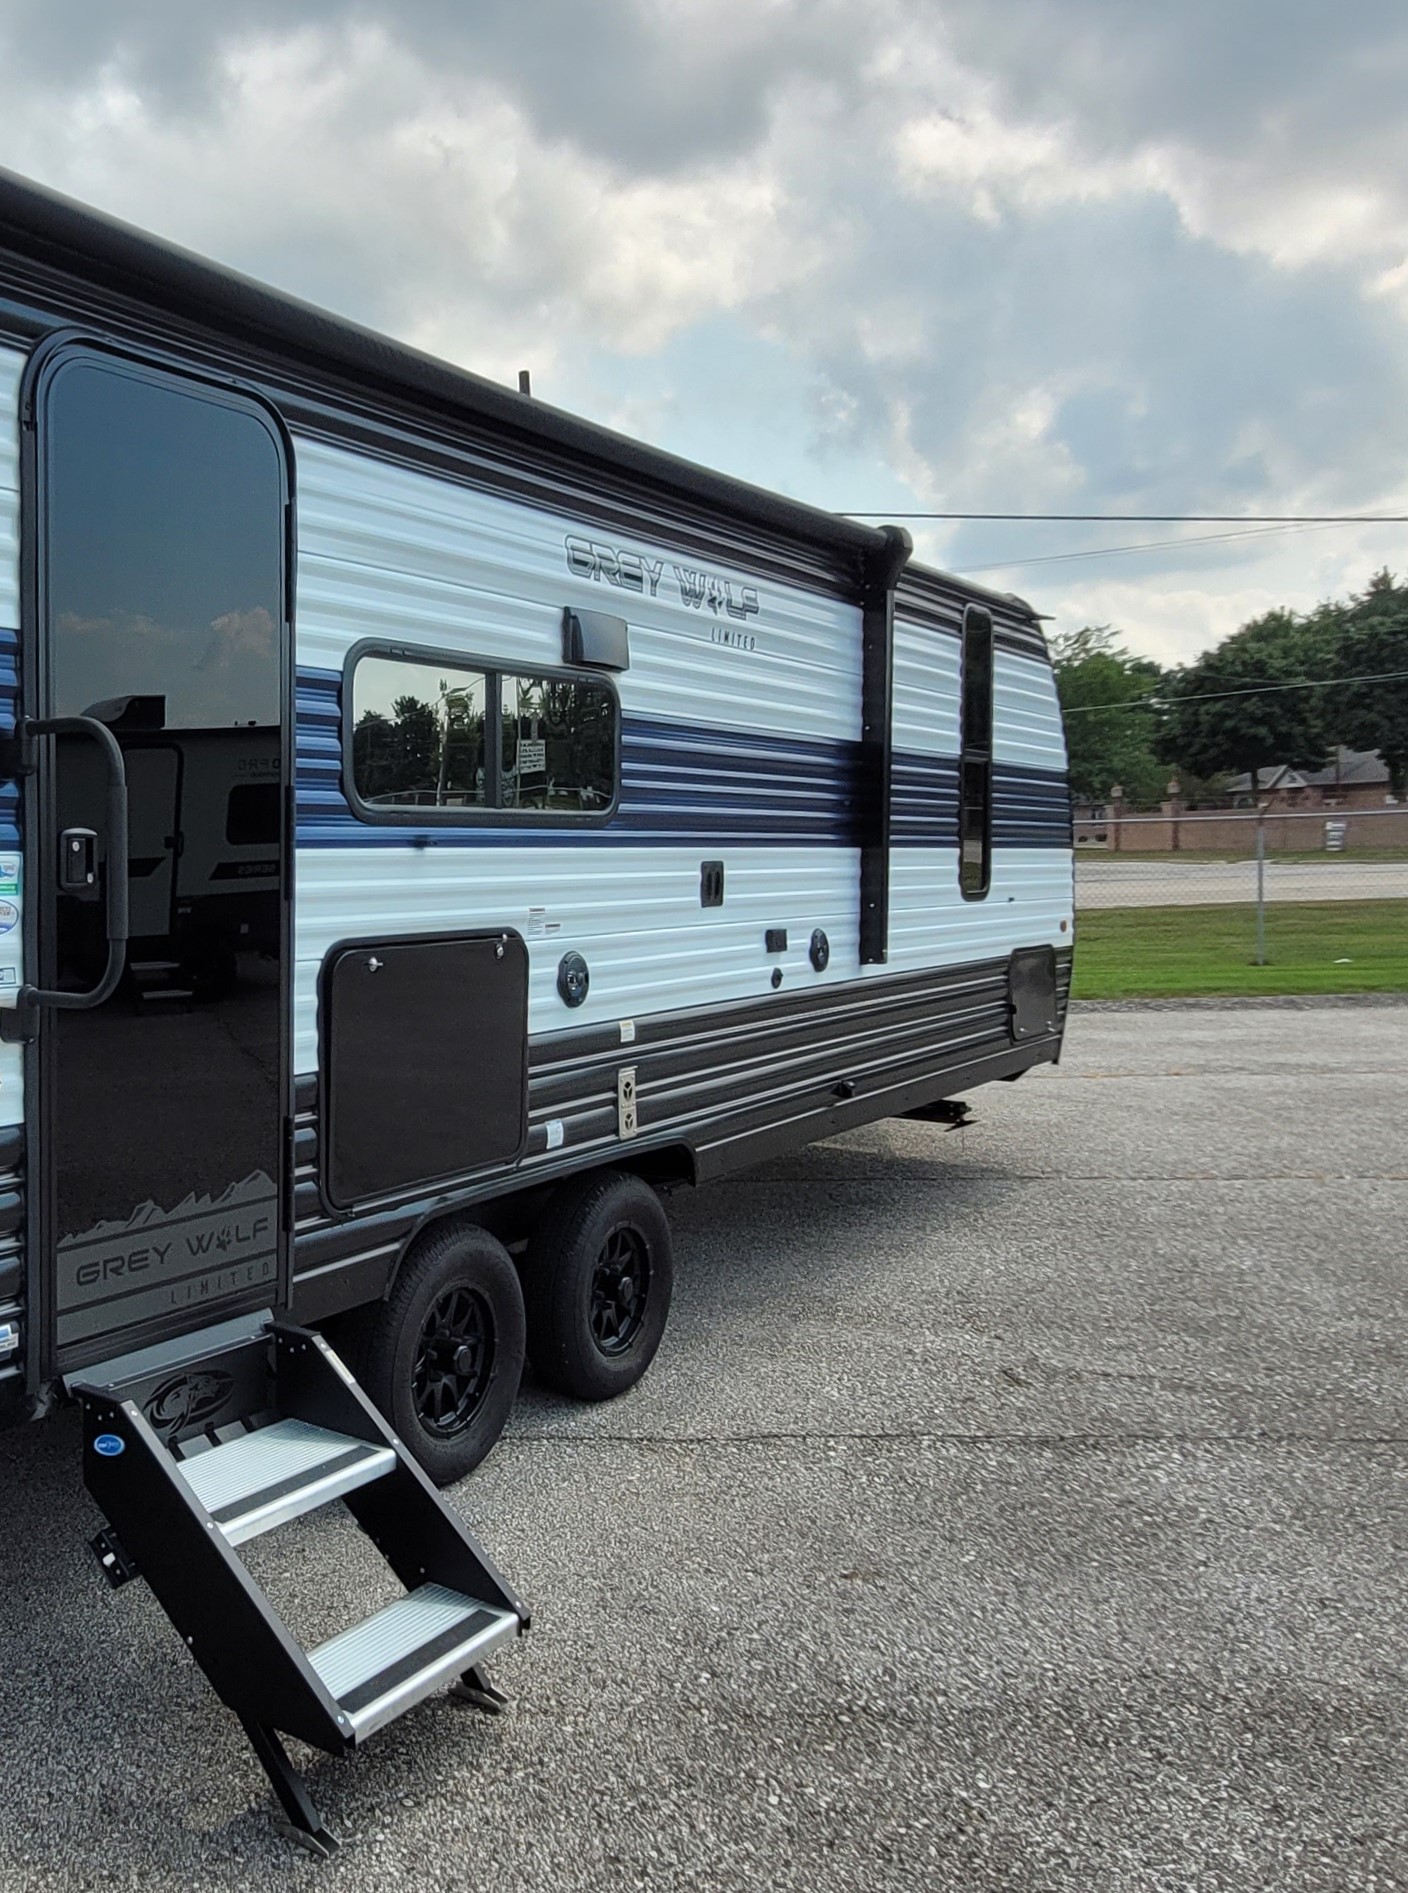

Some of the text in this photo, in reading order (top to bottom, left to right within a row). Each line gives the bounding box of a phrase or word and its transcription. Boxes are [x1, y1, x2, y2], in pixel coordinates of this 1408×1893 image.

[564, 533, 665, 598] GREY
[711, 626, 756, 651] LIMITED
[76, 1241, 172, 1287] GREY
[170, 1261, 270, 1304] LIMITED
